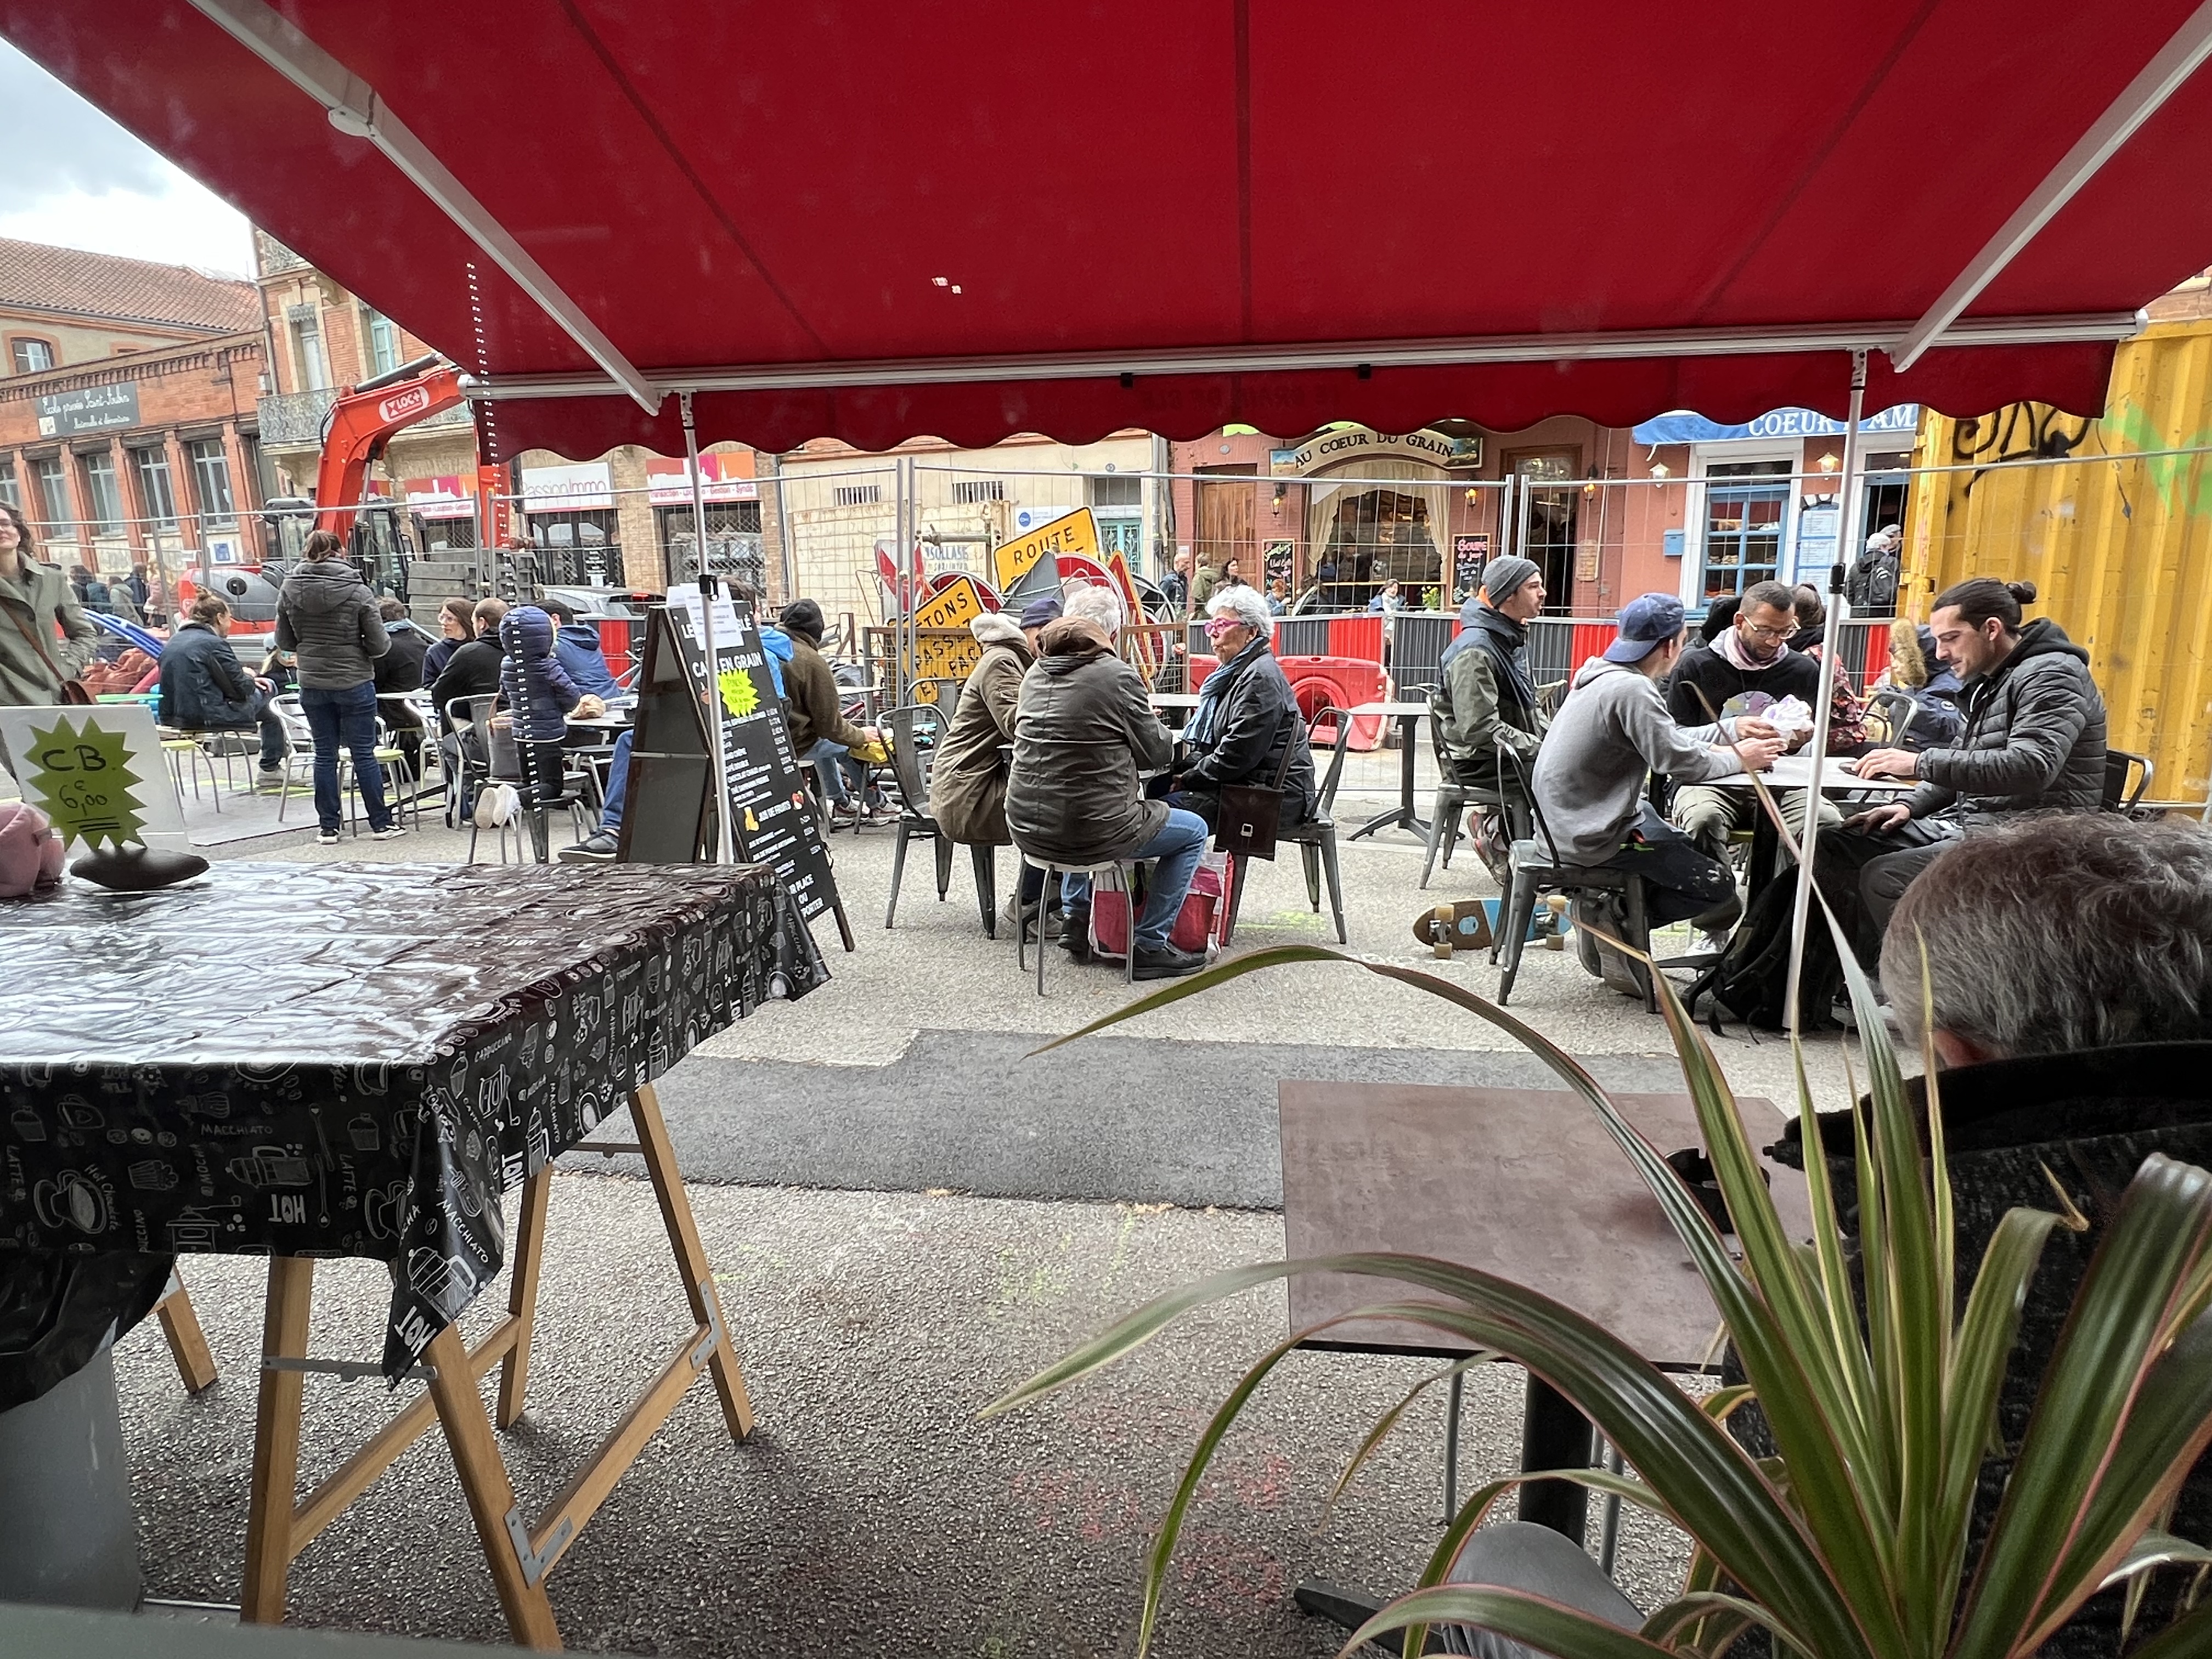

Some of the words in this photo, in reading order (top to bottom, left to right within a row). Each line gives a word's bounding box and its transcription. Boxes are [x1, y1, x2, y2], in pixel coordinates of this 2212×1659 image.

[1748, 411, 1836, 436] COEUR
[1295, 449, 1312, 468] AU
[1376, 433, 1398, 443] DU
[1406, 434, 1454, 458] GRAIN
[1014, 526, 1075, 566] ROUTE
[719, 657, 735, 673] EN
[733, 651, 764, 670] GRAIN
[795, 873, 814, 891] PLACE
[798, 891, 809, 904] OU
[800, 897, 824, 917] PORTER
[201, 1124, 273, 1136] MACCHIATO
[7, 1144, 25, 1184] LATTE
[339, 1153, 357, 1193] LATTE
[501, 1151, 525, 1192] HOT
[268, 1194, 306, 1224] HOT
[400, 1205, 421, 1240] CHA
[133, 1209, 151, 1253] PUCCINO
[436, 1199, 488, 1263] MACCHIATO
[393, 1305, 438, 1357] HOT
